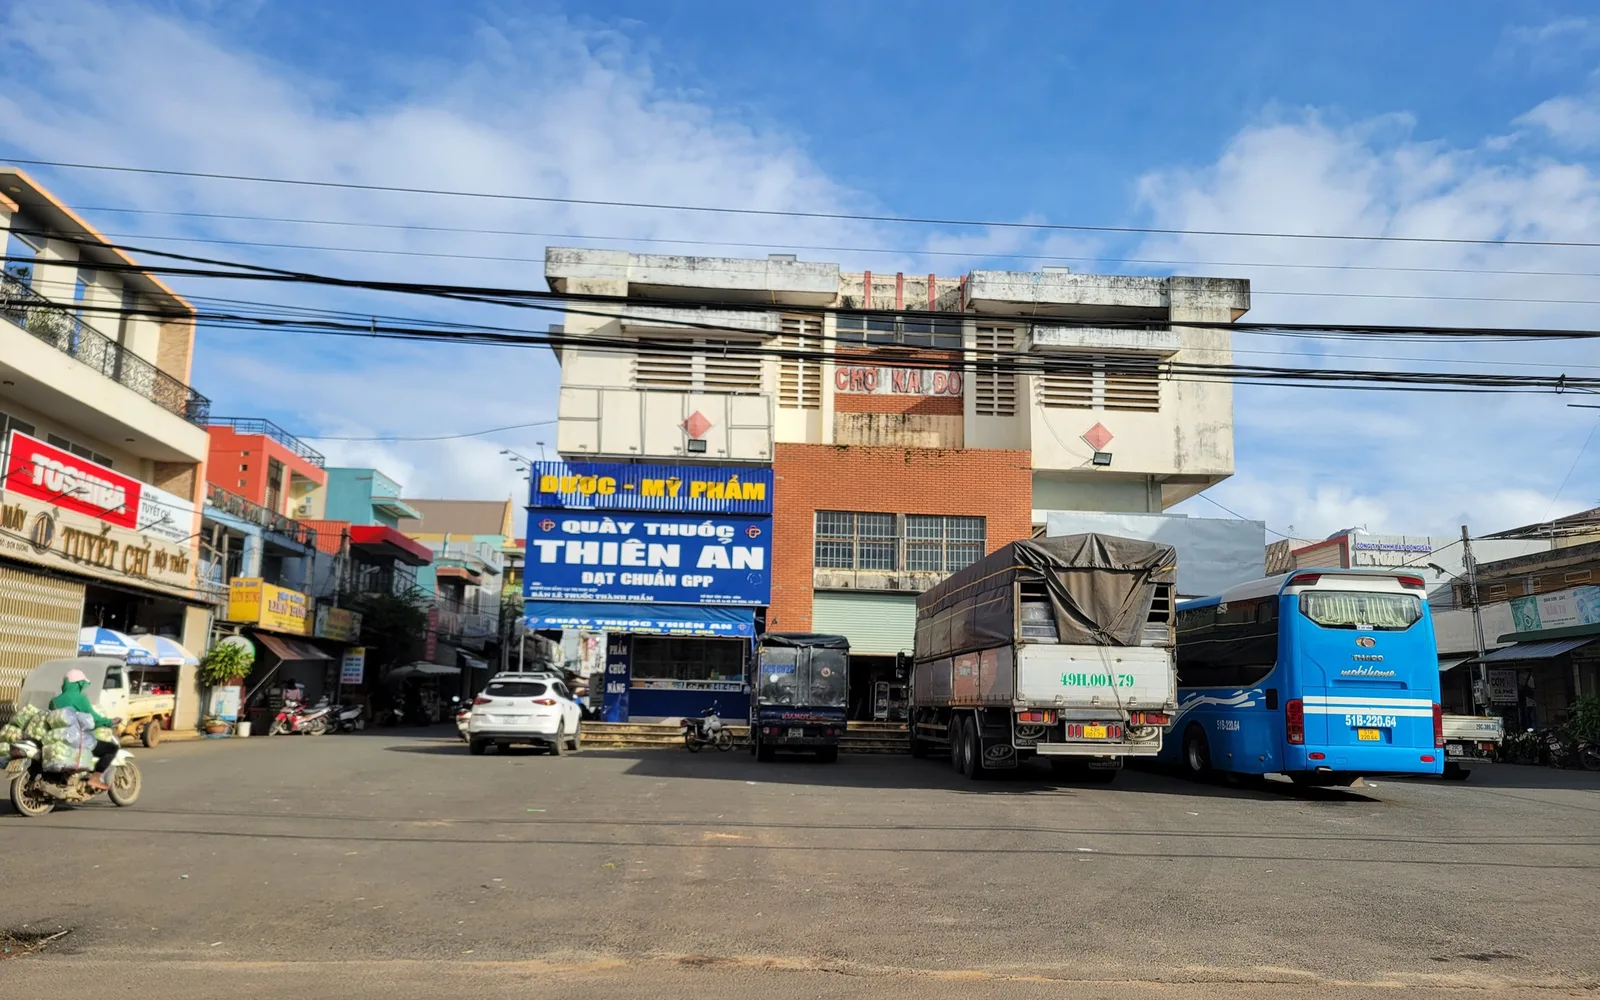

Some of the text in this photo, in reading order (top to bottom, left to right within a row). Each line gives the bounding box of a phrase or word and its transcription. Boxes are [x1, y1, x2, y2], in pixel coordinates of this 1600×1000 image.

[892, 368, 921, 393] KA
[31, 452, 126, 516] TOSHIBA
[642, 476, 683, 498] MỸ
[690, 474, 766, 501] PHẨM
[561, 516, 735, 539] QUẦY THUỐC
[61, 528, 119, 572] TUYẾT
[122, 541, 152, 580] CHÍ
[533, 538, 681, 568] THIÊN
[581, 569, 714, 588] ĐẠT CHUẨN GPP
[1340, 665, 1397, 678] mobihome
[1216, 719, 1241, 731] 51B-220.64
[1346, 714, 1397, 728] 51B-220.64
